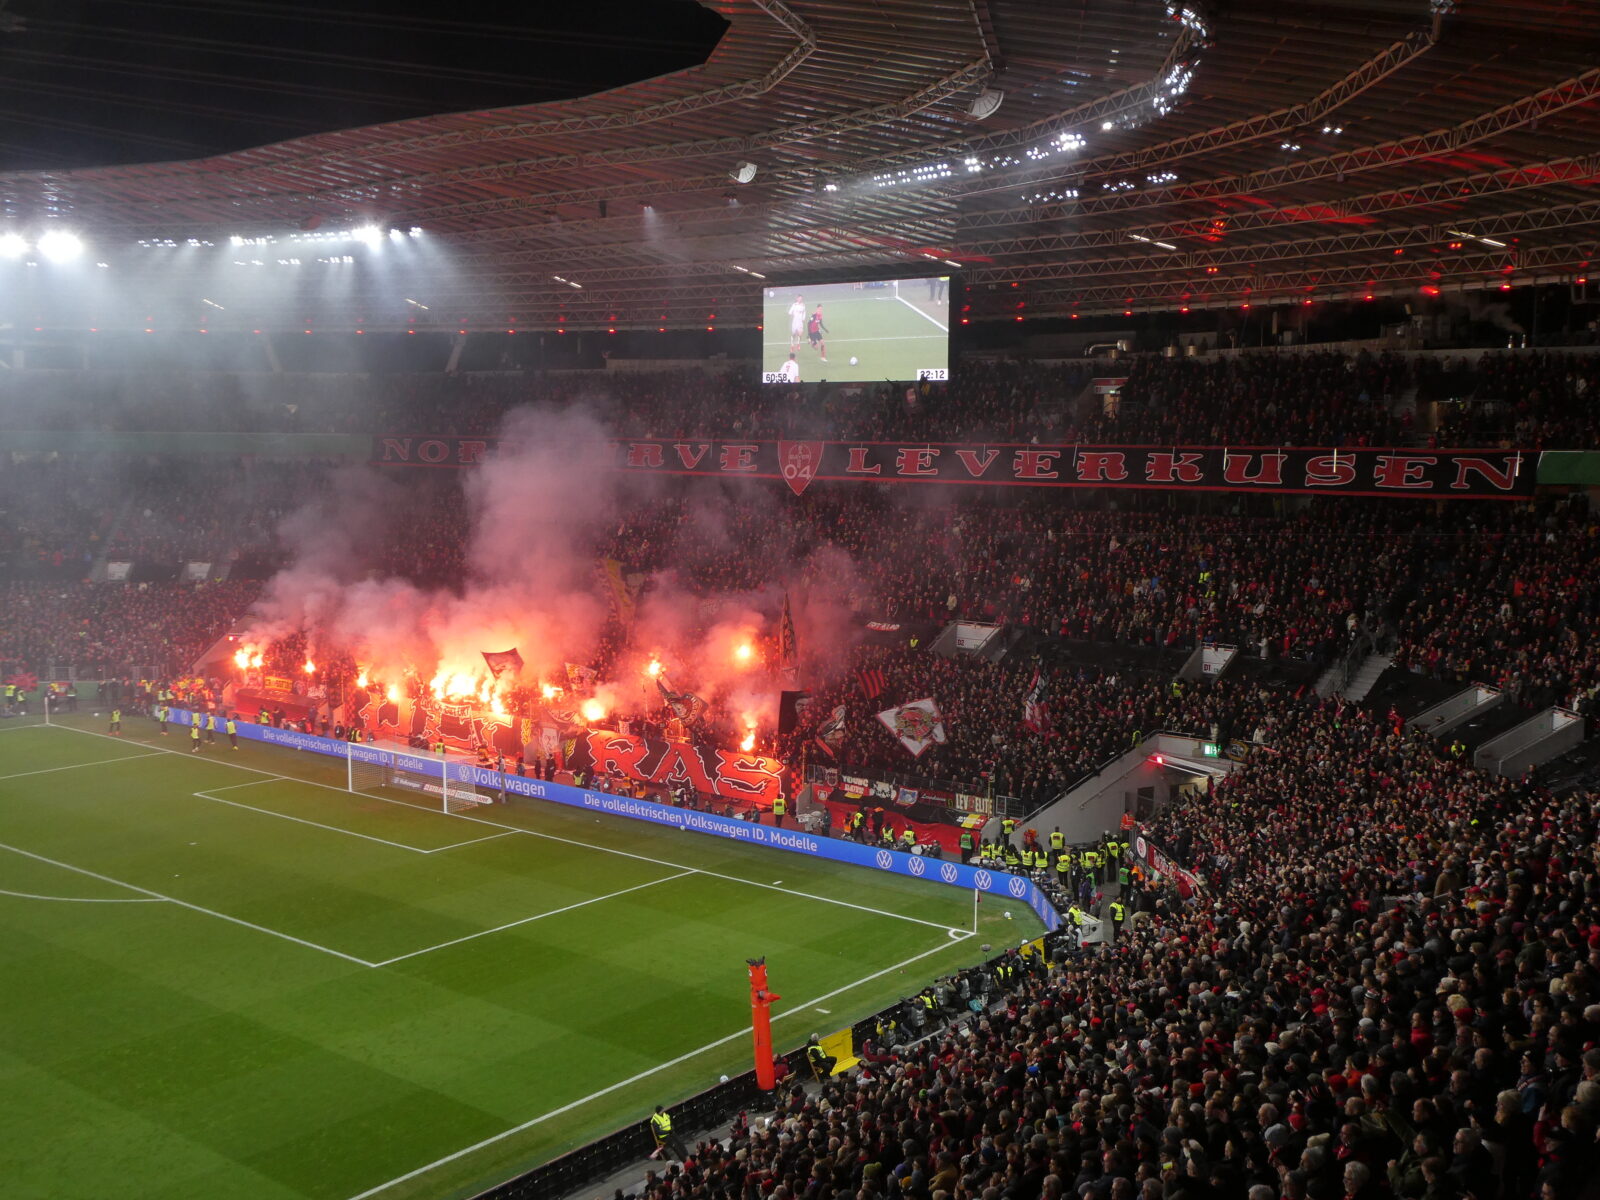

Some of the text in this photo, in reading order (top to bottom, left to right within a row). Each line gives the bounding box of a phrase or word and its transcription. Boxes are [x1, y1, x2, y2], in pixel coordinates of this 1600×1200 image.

[765, 373, 788, 382] 60:58
[382, 438, 758, 472] NORRVE
[845, 447, 1524, 490] LEVERKUSEN
[784, 464, 811, 480] 04
[263, 729, 275, 740] Die
[276, 732, 332, 752] vollelektrischen
[332, 743, 378, 762] Volkwagen
[472, 768, 545, 796] Volkswagen
[583, 793, 818, 852] Die vollelektrischen Volkswagen ID. Modelle
